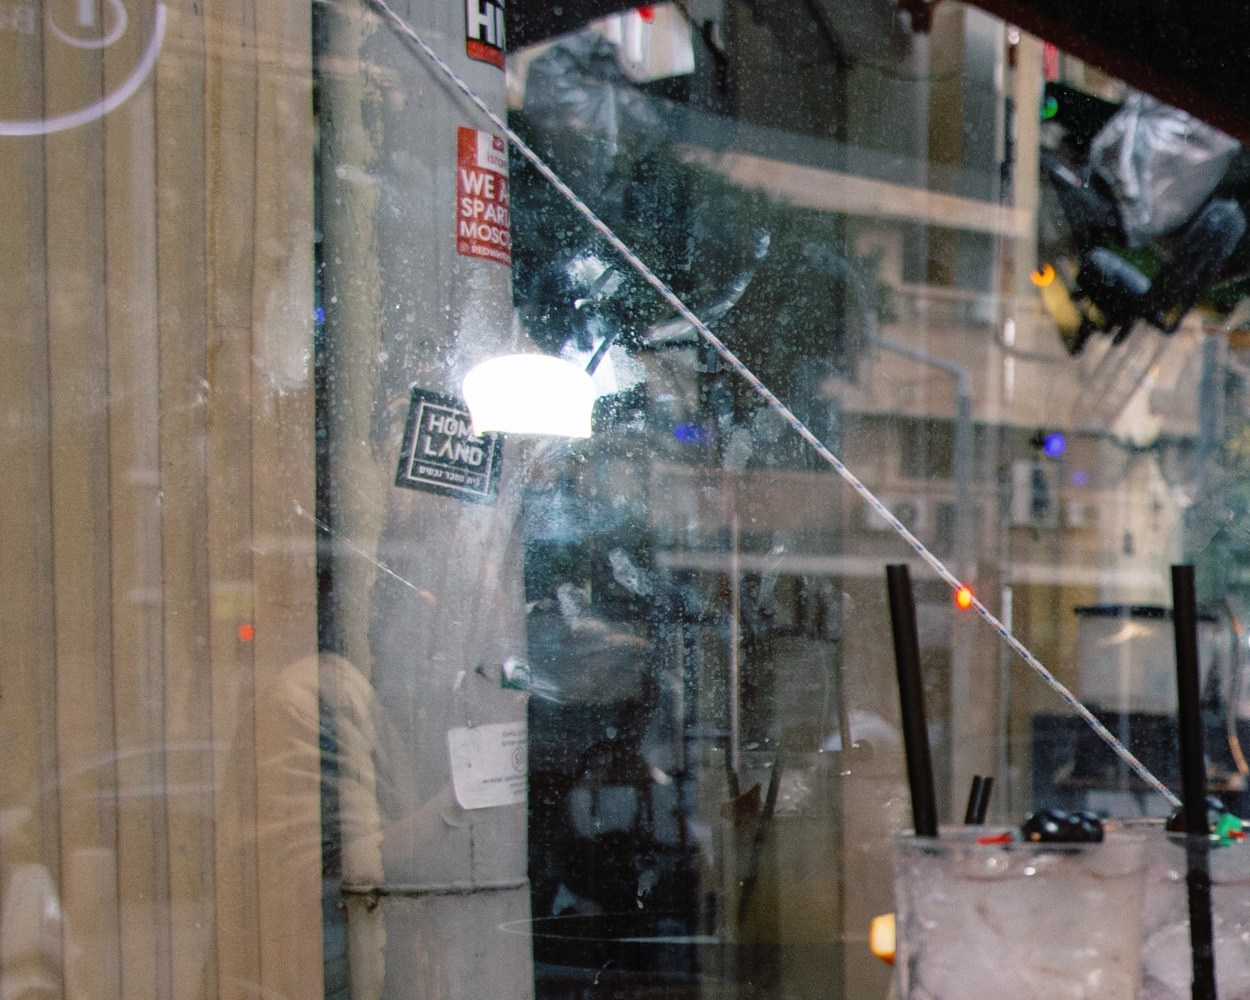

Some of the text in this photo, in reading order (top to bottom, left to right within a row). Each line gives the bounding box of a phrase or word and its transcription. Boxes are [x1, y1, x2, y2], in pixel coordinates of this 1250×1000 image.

[461, 168, 510, 204] WE A
[461, 197, 510, 228] SPART
[460, 220, 510, 247] MOSC
[424, 434, 483, 466] LAND
